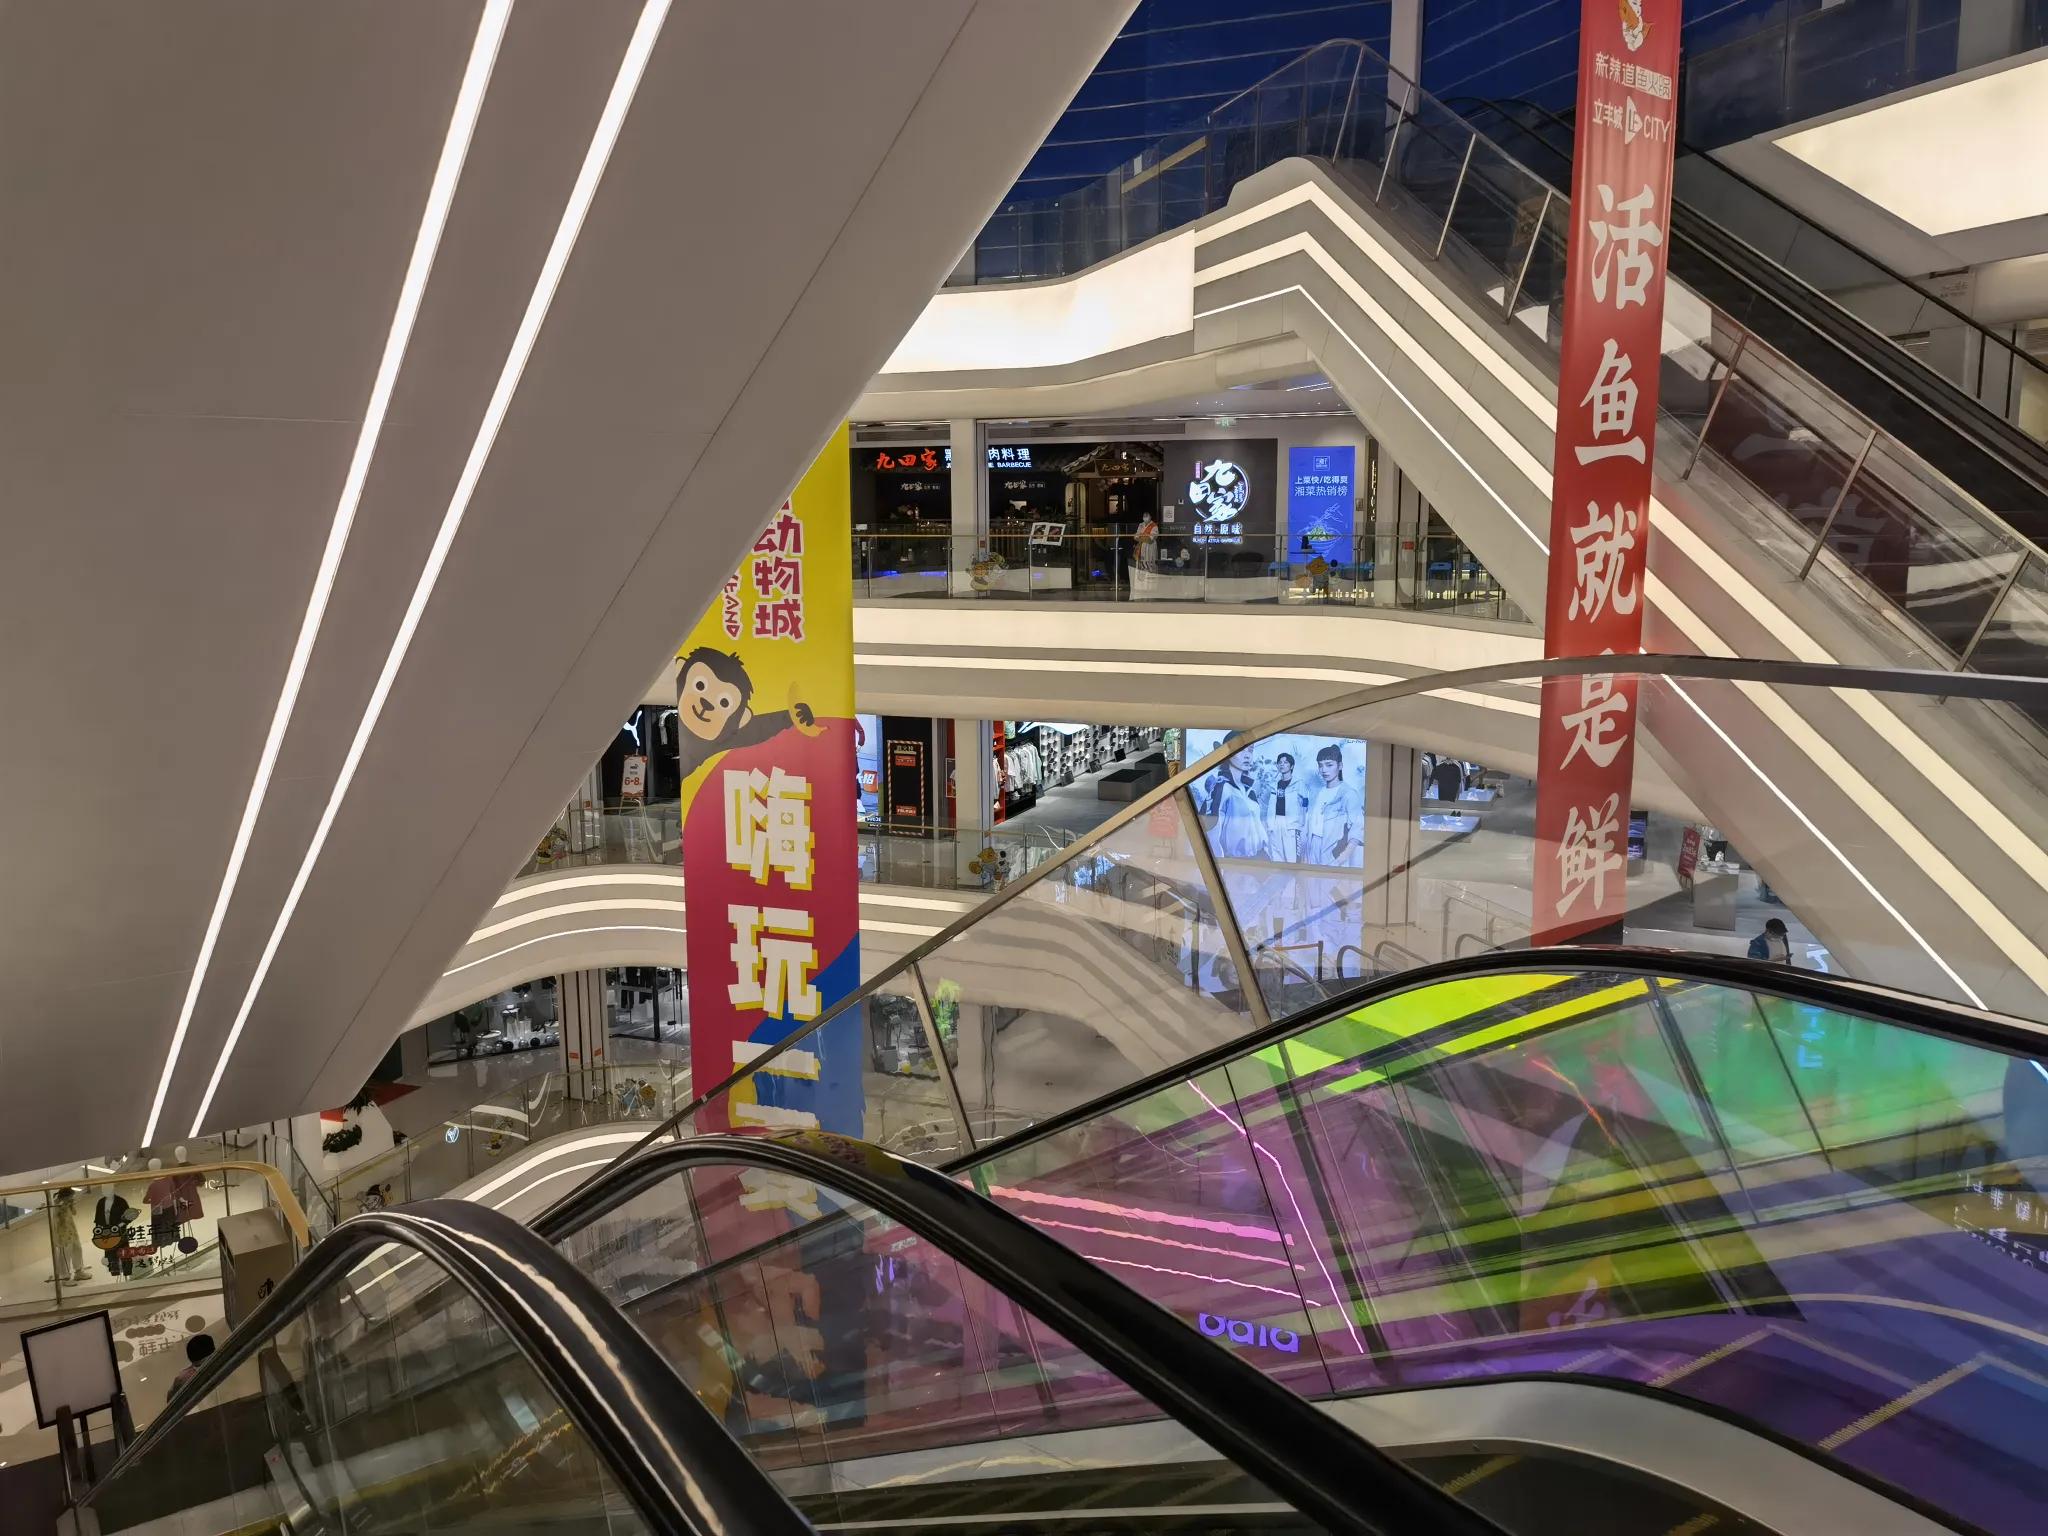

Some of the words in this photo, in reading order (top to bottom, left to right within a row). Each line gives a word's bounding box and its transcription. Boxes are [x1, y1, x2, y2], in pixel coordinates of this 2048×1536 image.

[1593, 98, 1623, 131] 立丰城
[1643, 115, 1671, 143] CITY
[876, 448, 938, 471] 九田家
[1189, 459, 1236, 522] 九田家
[1294, 486, 1349, 497] 湘菜热销榜
[1555, 183, 1664, 918] 活鱼就是鲜
[752, 500, 803, 640] 动物城
[1199, 1312, 1300, 1353] bala
